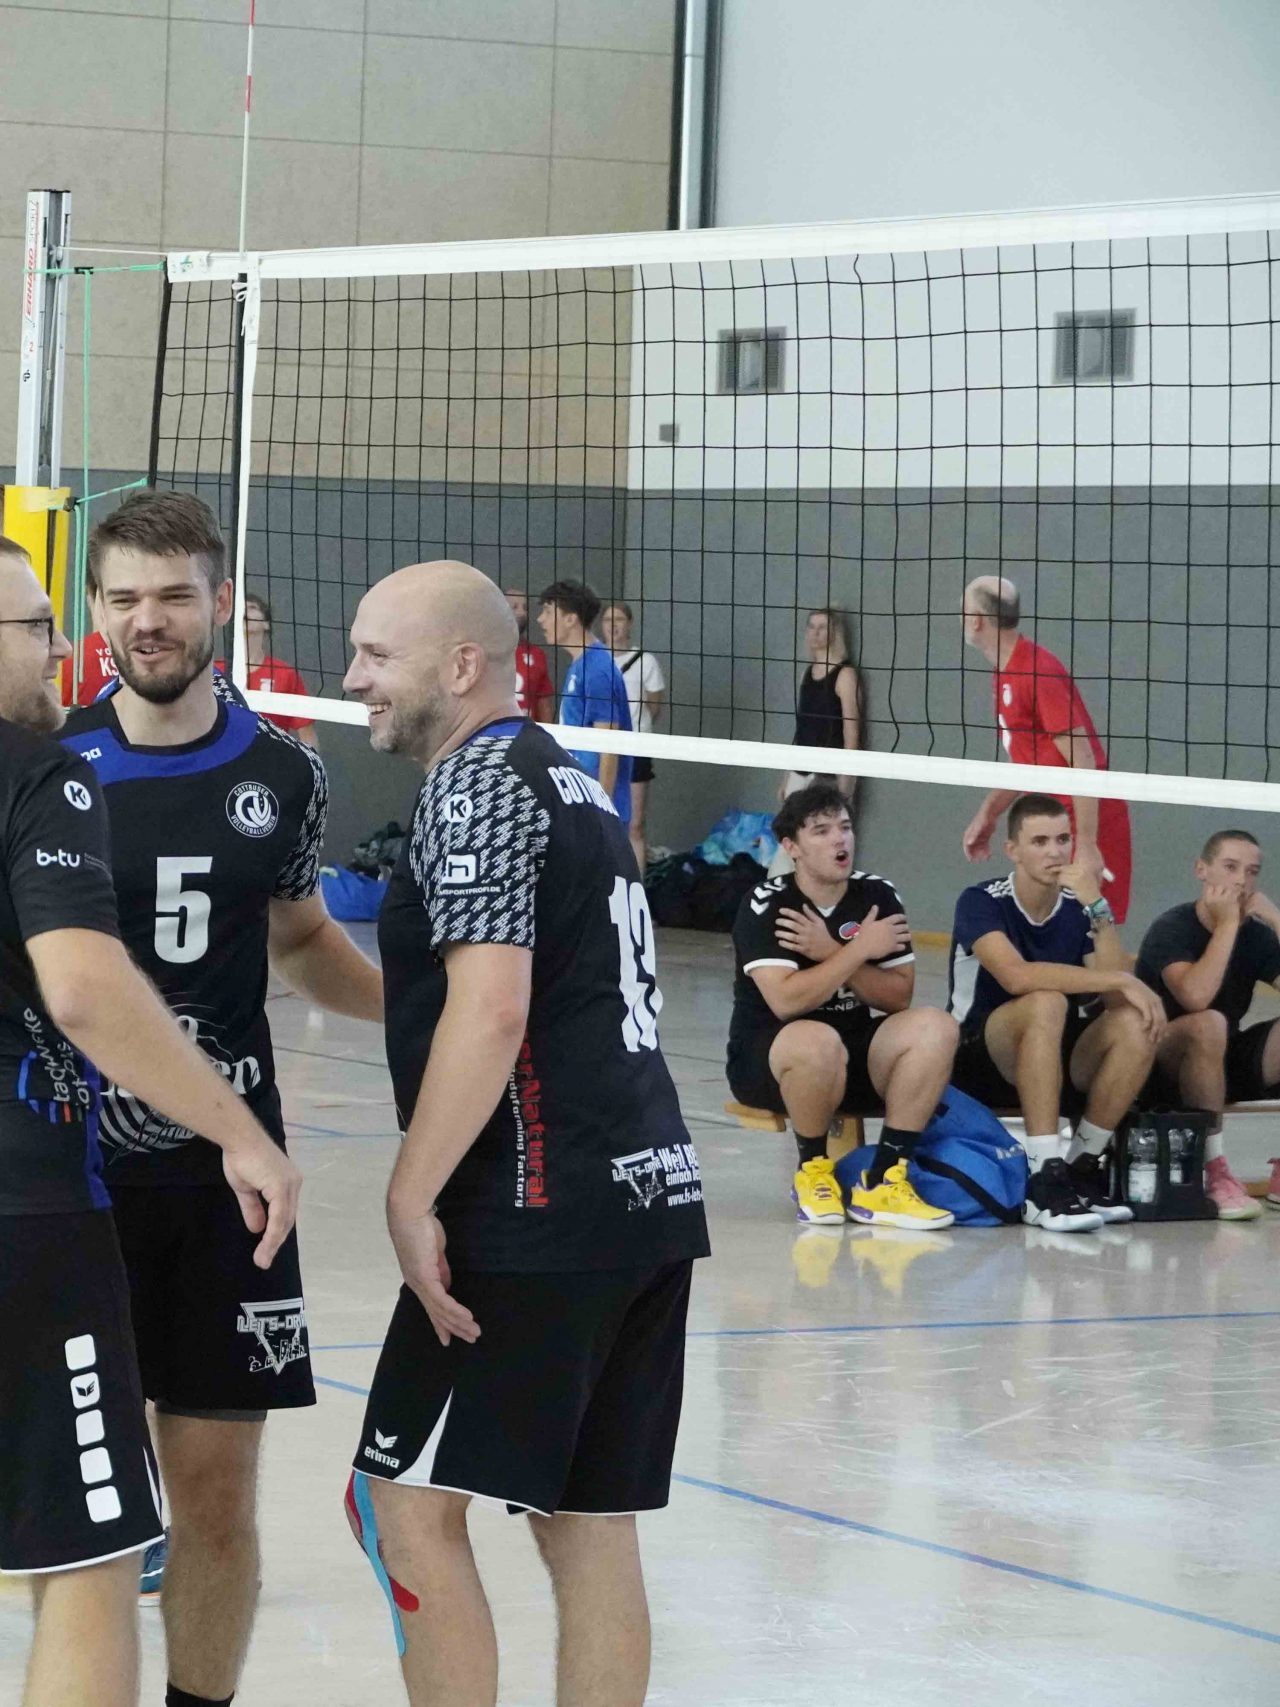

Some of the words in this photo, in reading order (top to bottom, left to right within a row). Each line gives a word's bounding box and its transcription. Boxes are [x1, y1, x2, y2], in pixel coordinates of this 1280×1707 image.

[233, 784, 270, 797] COTTBUSER
[154, 856, 213, 964] 5
[657, 1144, 687, 1173] Weil
[515, 1153, 528, 1208] Factory
[364, 1446, 400, 1469] erima
